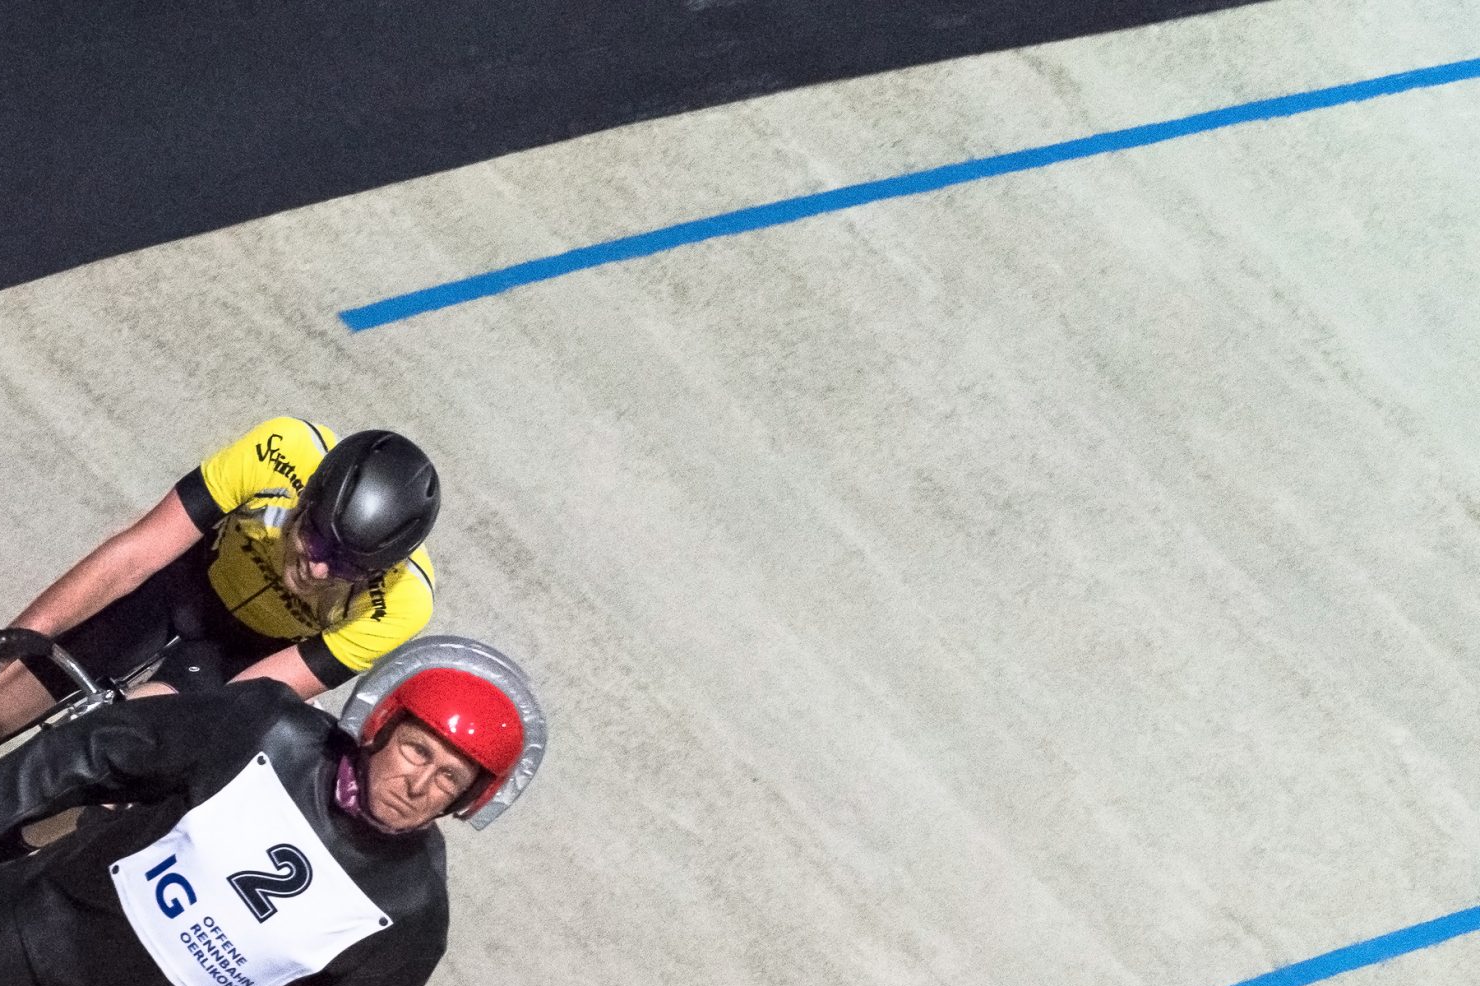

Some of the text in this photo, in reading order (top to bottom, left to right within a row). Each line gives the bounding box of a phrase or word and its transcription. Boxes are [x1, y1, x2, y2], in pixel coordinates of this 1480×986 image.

[145, 854, 198, 920] IG
[225, 843, 314, 924] 2
[203, 916, 247, 967] OFFENE
